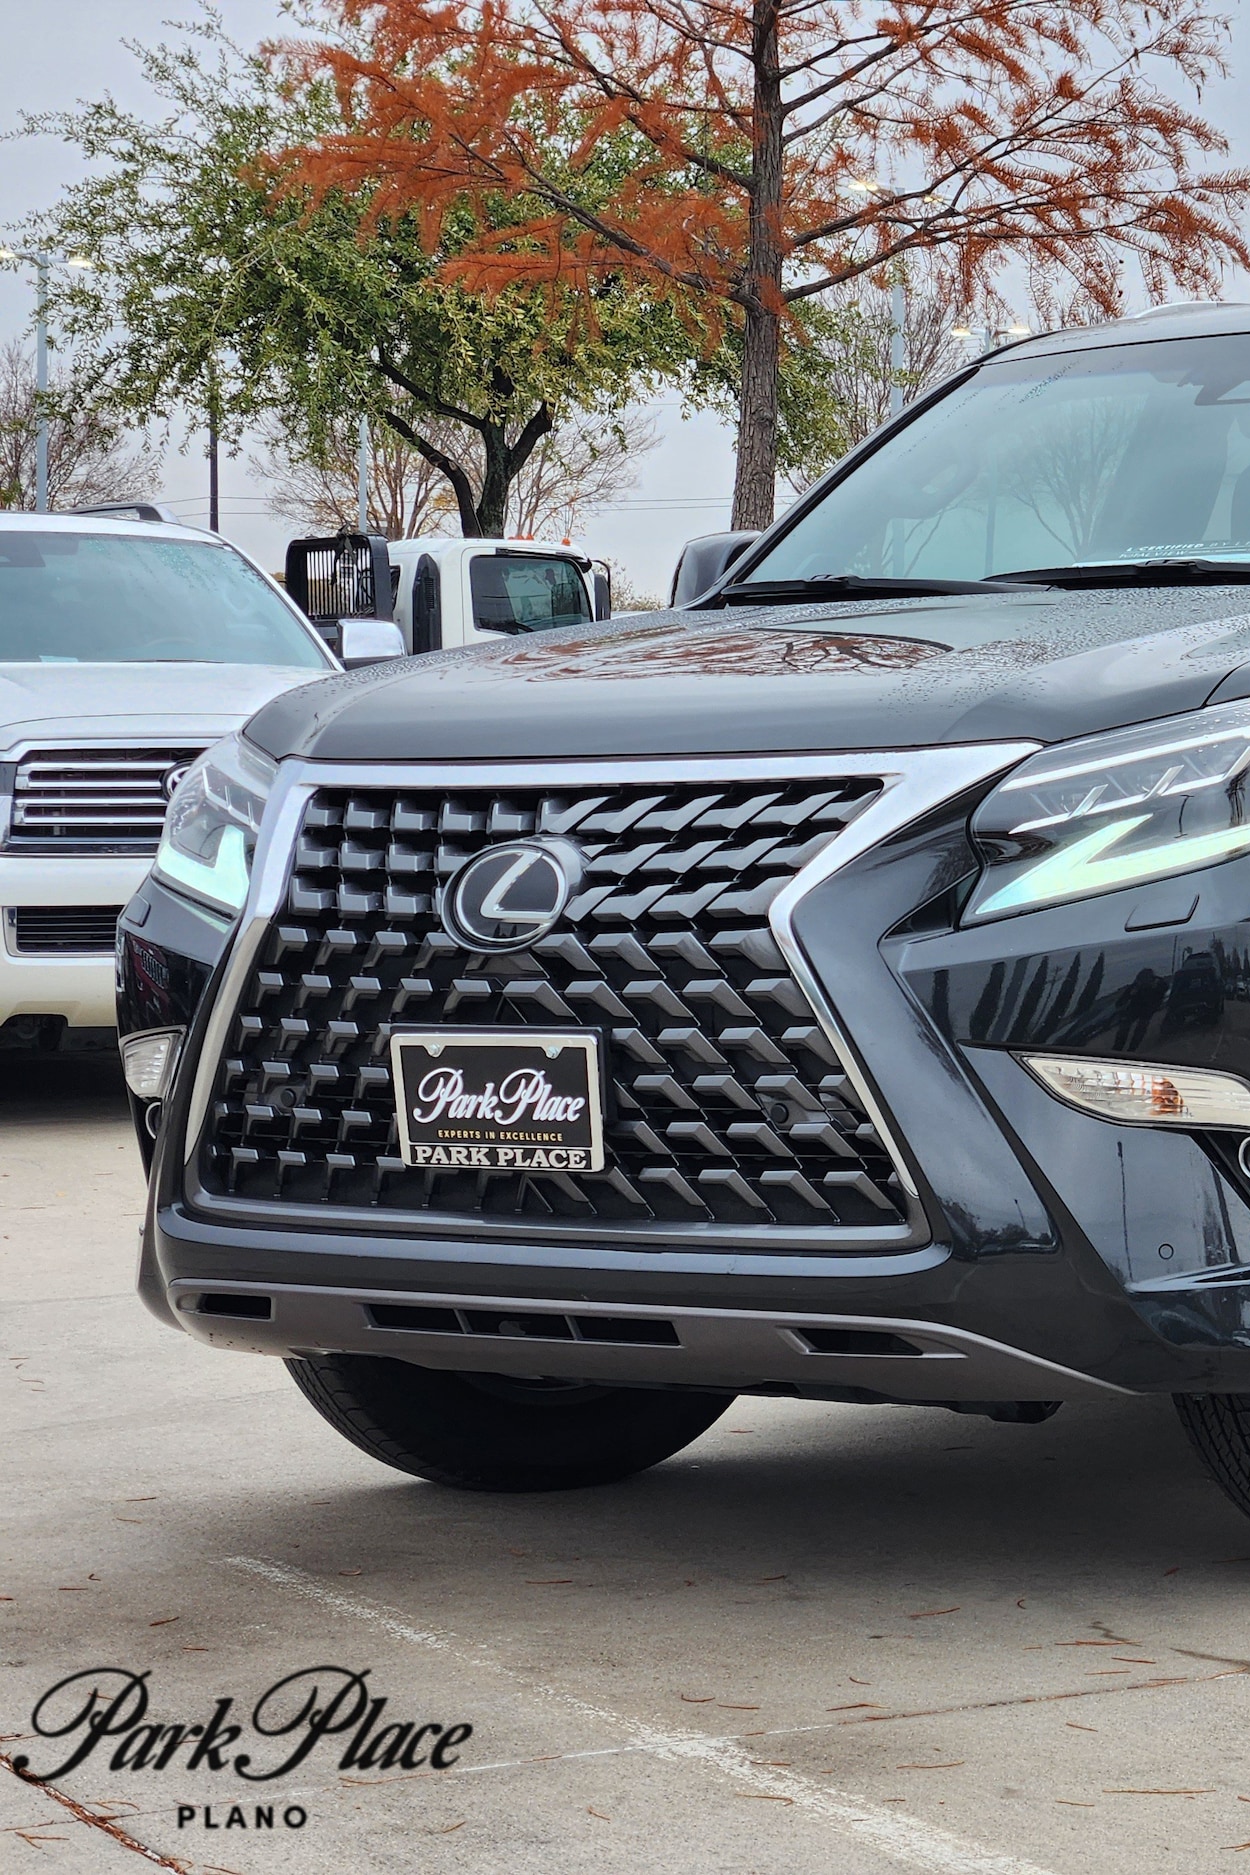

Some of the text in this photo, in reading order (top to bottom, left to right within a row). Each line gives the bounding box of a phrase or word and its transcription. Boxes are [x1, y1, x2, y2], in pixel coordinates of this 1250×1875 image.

[413, 1067, 586, 1126] Park Place
[437, 1129, 564, 1142] EXPERTS IN EXCELLENCE
[414, 1146, 587, 1169] PARK PLACE
